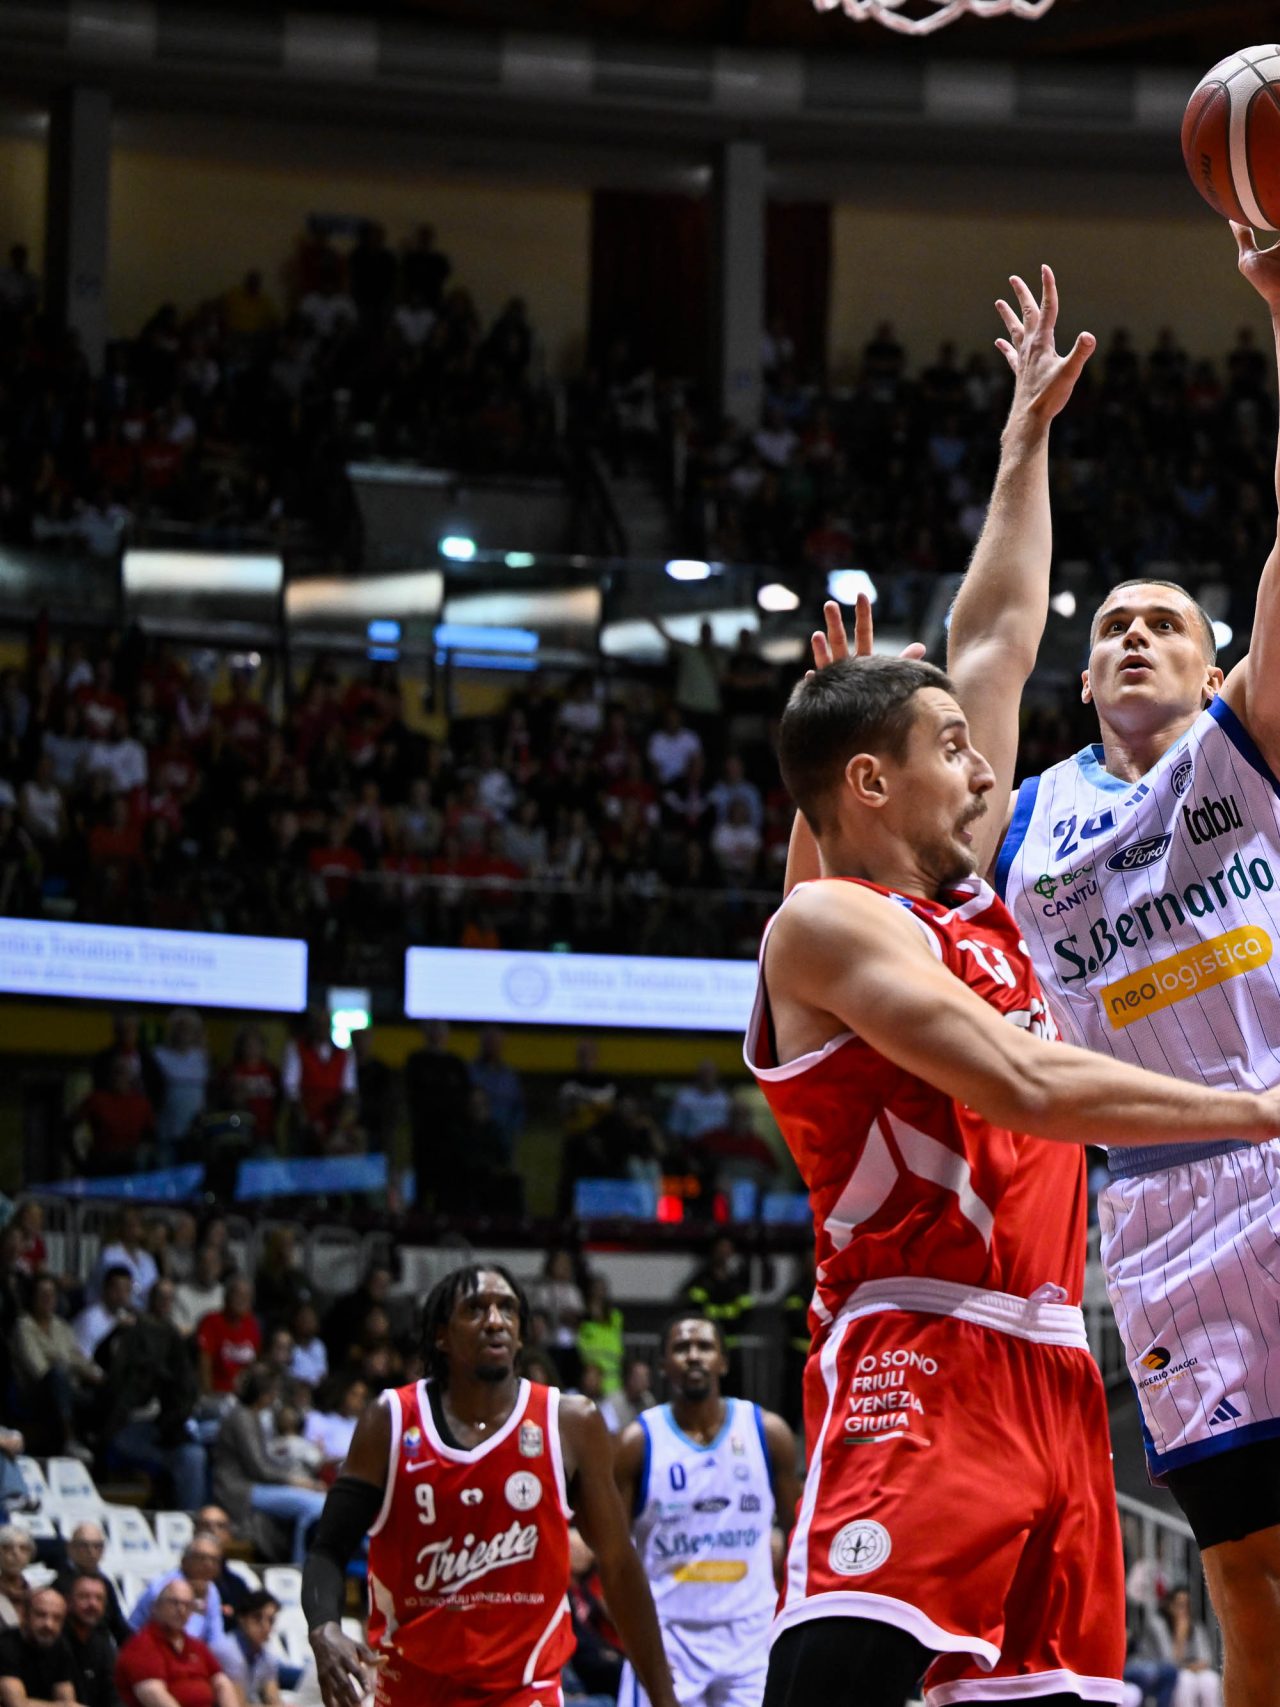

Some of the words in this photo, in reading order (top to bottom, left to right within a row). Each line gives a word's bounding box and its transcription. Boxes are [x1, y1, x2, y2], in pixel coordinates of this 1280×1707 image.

[1182, 795, 1243, 845] tabu
[1119, 837, 1169, 870] Ford
[1043, 879, 1097, 917] CANTÙ
[1110, 937, 1263, 1015] neologistica
[880, 1349, 939, 1376] SONO
[1169, 1357, 1199, 1375] VIAGGI
[852, 1369, 906, 1394] FRIULI
[848, 1390, 925, 1416] VENEZIA
[844, 1412, 910, 1433] GIULIA
[669, 1463, 687, 1492] 0
[415, 1483, 437, 1525] 9
[414, 1519, 539, 1592] Trieste
